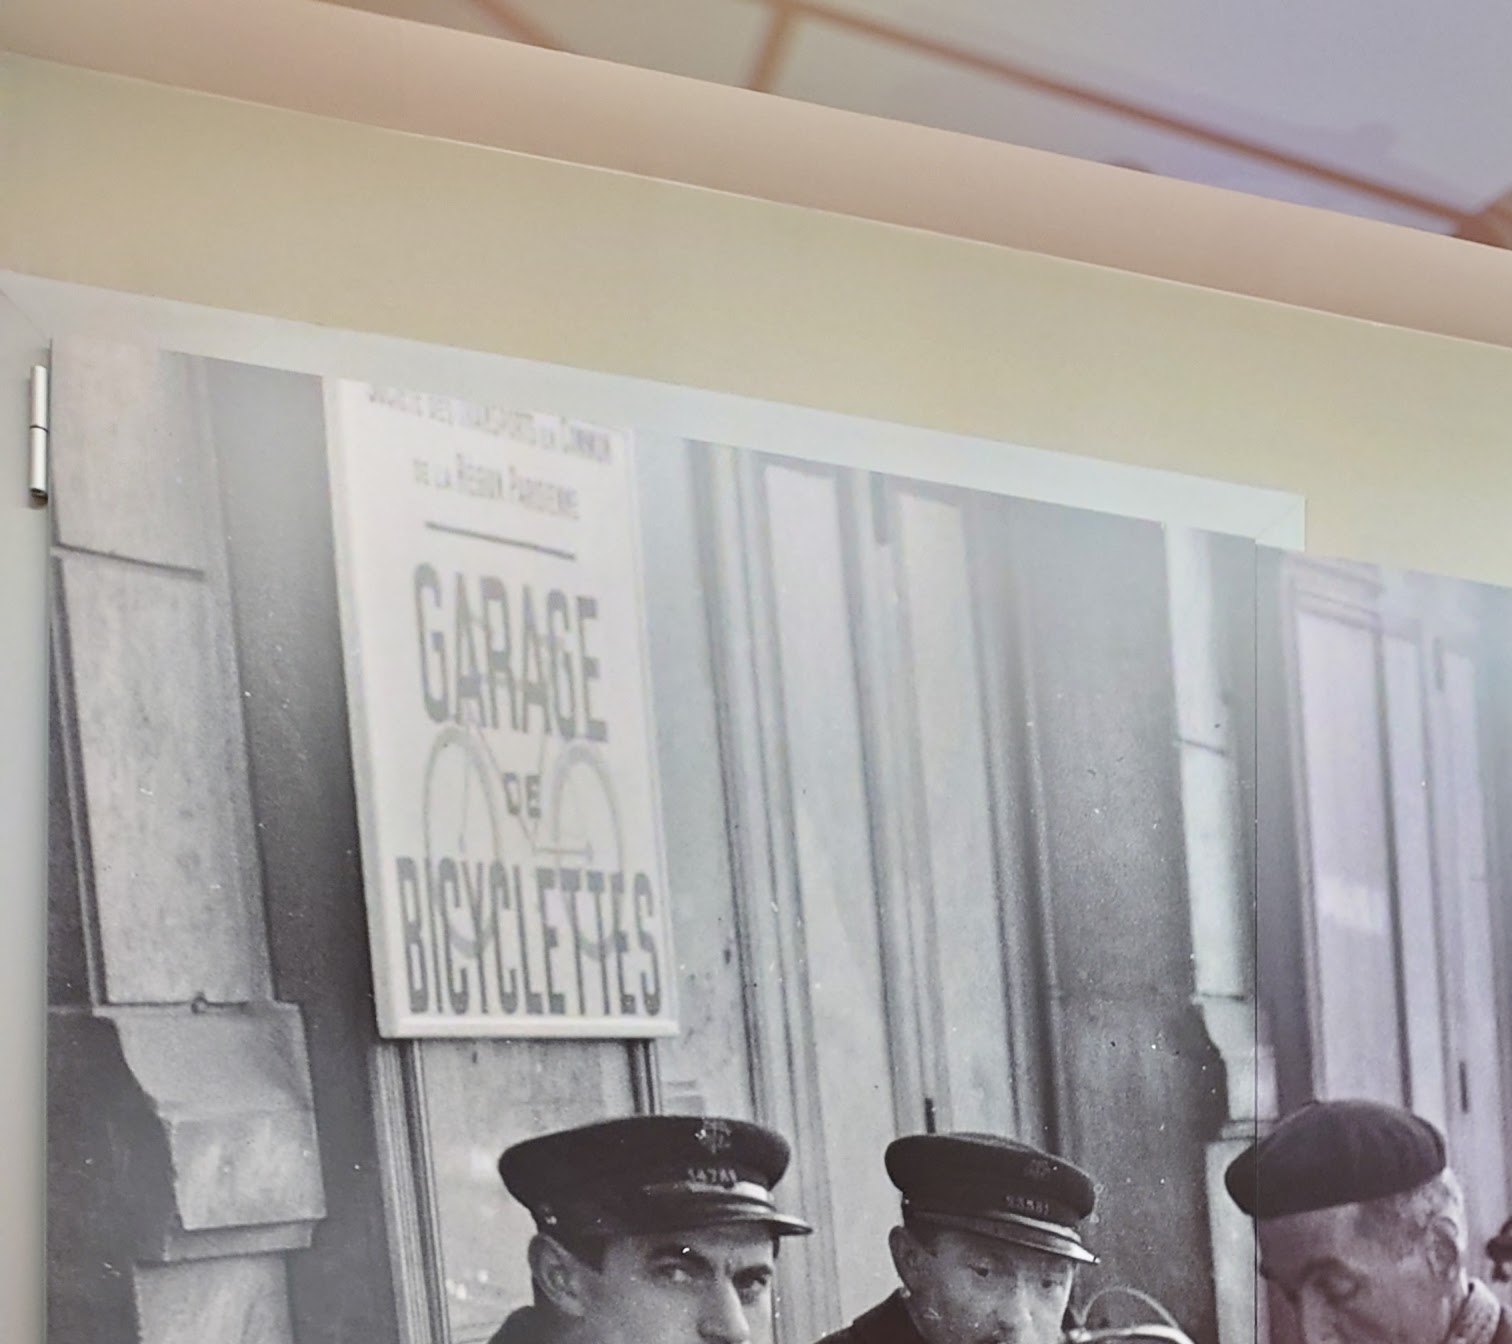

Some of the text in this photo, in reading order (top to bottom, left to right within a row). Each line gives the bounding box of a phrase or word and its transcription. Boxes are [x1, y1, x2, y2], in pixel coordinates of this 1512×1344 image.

[414, 560, 609, 743] GARAGE
[503, 771, 543, 819] DE
[395, 856, 663, 1017] BICYCLETTES
